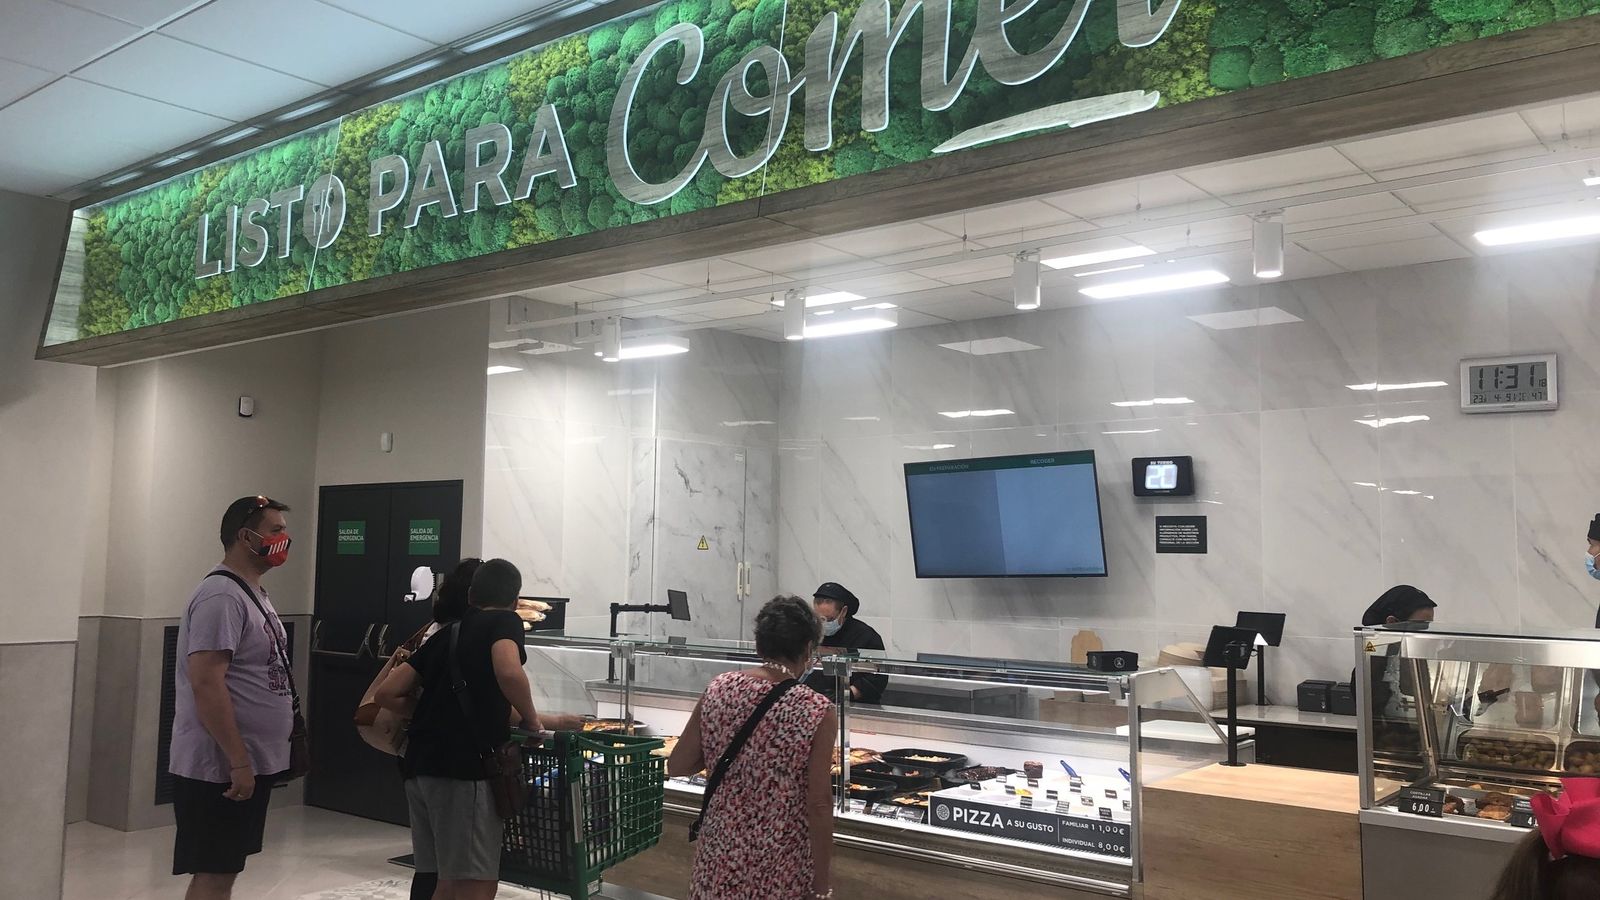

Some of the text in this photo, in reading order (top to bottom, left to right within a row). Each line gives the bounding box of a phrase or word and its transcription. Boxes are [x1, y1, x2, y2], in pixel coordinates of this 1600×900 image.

[194, 174, 347, 280] LISTO
[367, 103, 578, 237] PARA
[1478, 364, 1535, 390] 11:31
[953, 807, 1004, 829] PIZZA
[1026, 822, 1054, 833] GUSTO
[1062, 820, 1089, 829] FAMILIAR
[1062, 837, 1125, 853] INDIVIDUAL 8,00€
